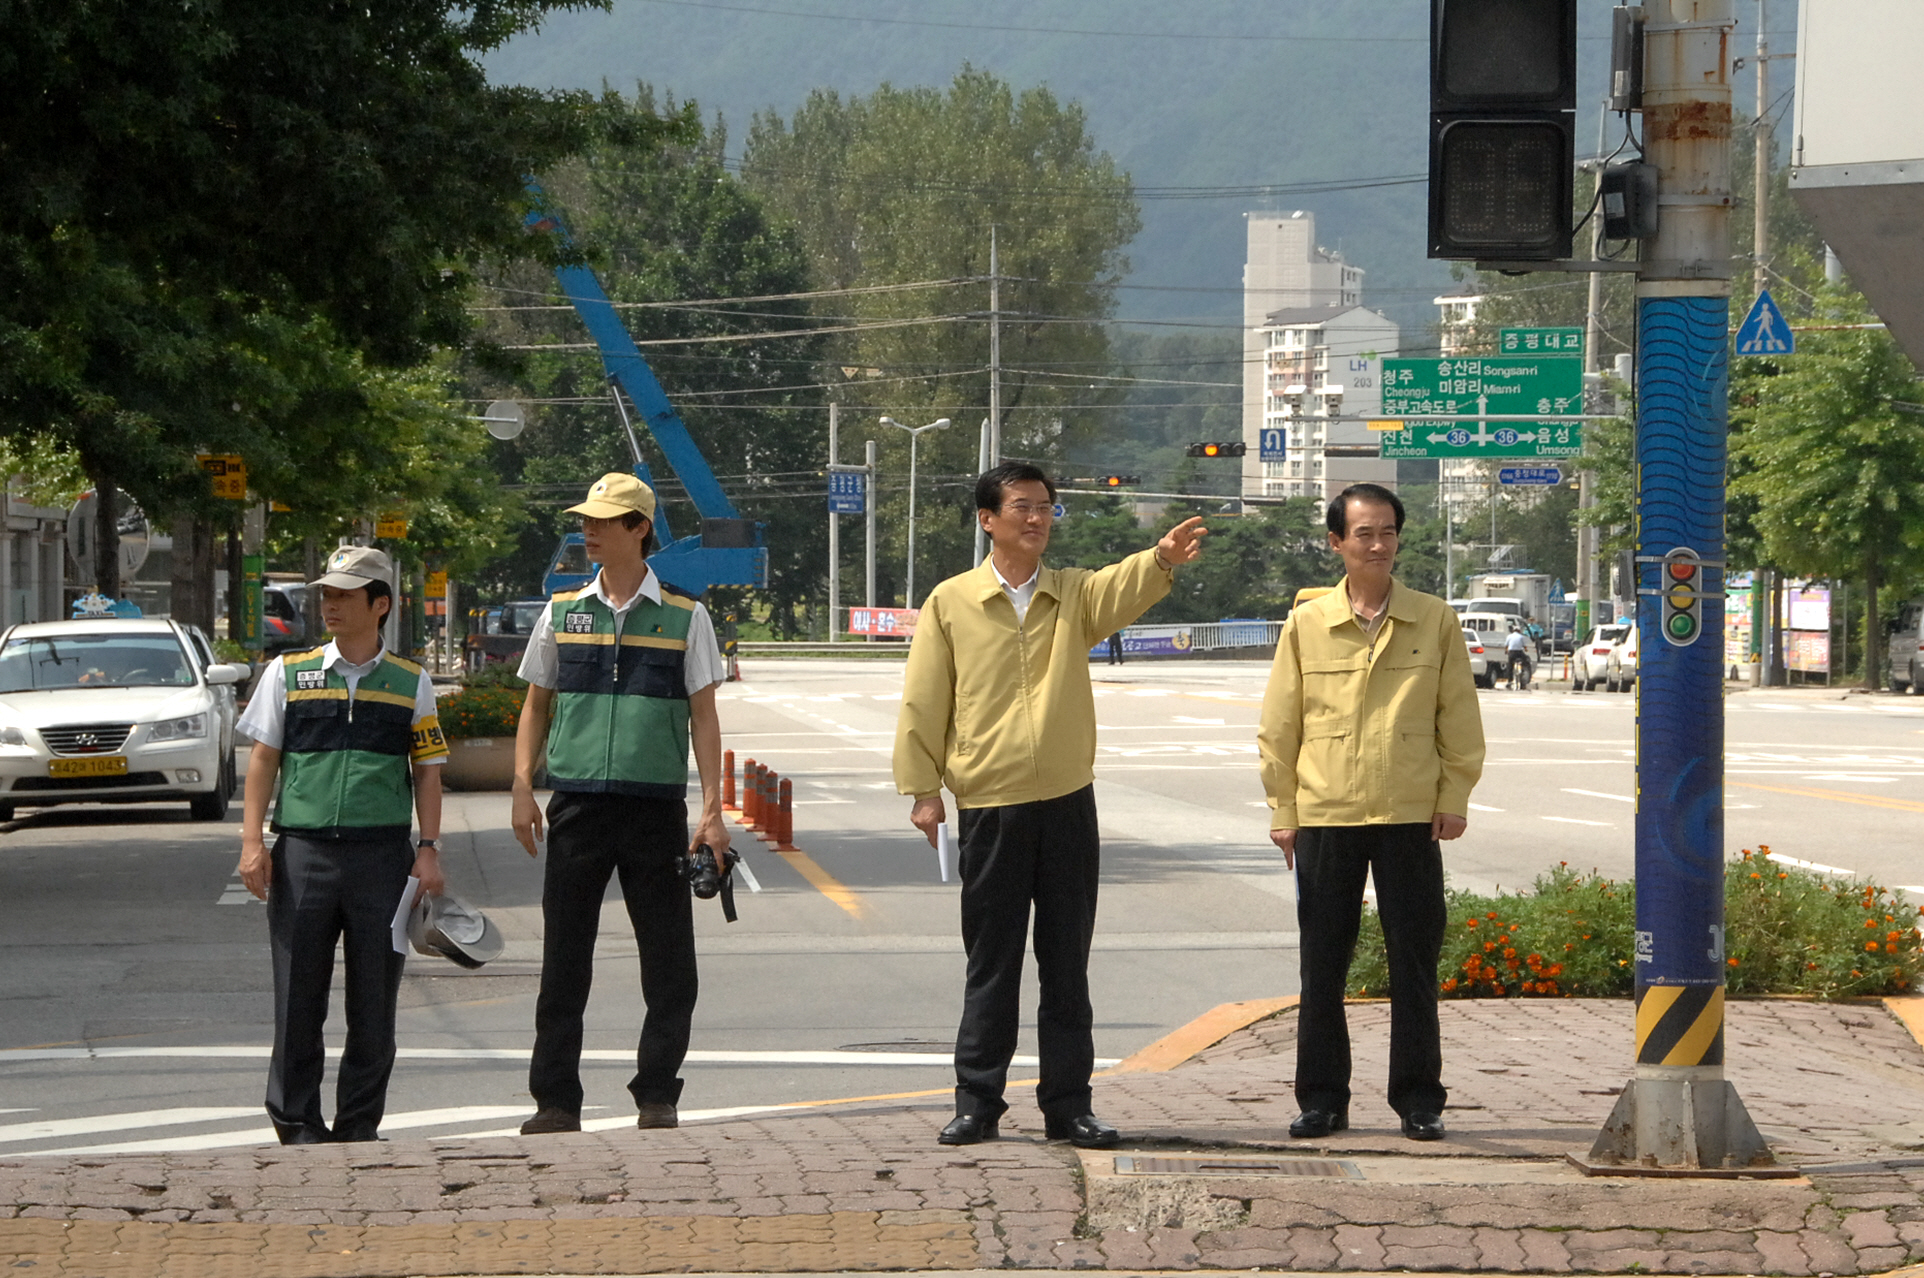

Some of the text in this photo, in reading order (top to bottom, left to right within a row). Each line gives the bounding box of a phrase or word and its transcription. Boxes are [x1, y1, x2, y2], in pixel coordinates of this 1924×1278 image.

[1505, 333, 1579, 349] 증평대교
[1350, 360, 1367, 371] LH
[1437, 360, 1481, 376] 송산리
[1354, 377, 1372, 388] 203
[1383, 369, 1414, 385] 청주
[1384, 387, 1430, 398] Cheongju
[1439, 379, 1481, 394] 미암리
[1384, 399, 1458, 415] 중부고속도로
[1537, 398, 1569, 414] 충주
[1383, 430, 1413, 445] 진천
[1451, 432, 1466, 444] 36
[1498, 431, 1514, 443] 36
[1538, 427, 1569, 444] 음성
[1385, 446, 1427, 456] Jincheon
[1536, 445, 1580, 456] Umsong
[568, 615, 591, 624] 증평군
[567, 624, 591, 633] 민방위
[299, 672, 323, 680] 증평군
[298, 680, 324, 689] 민방위
